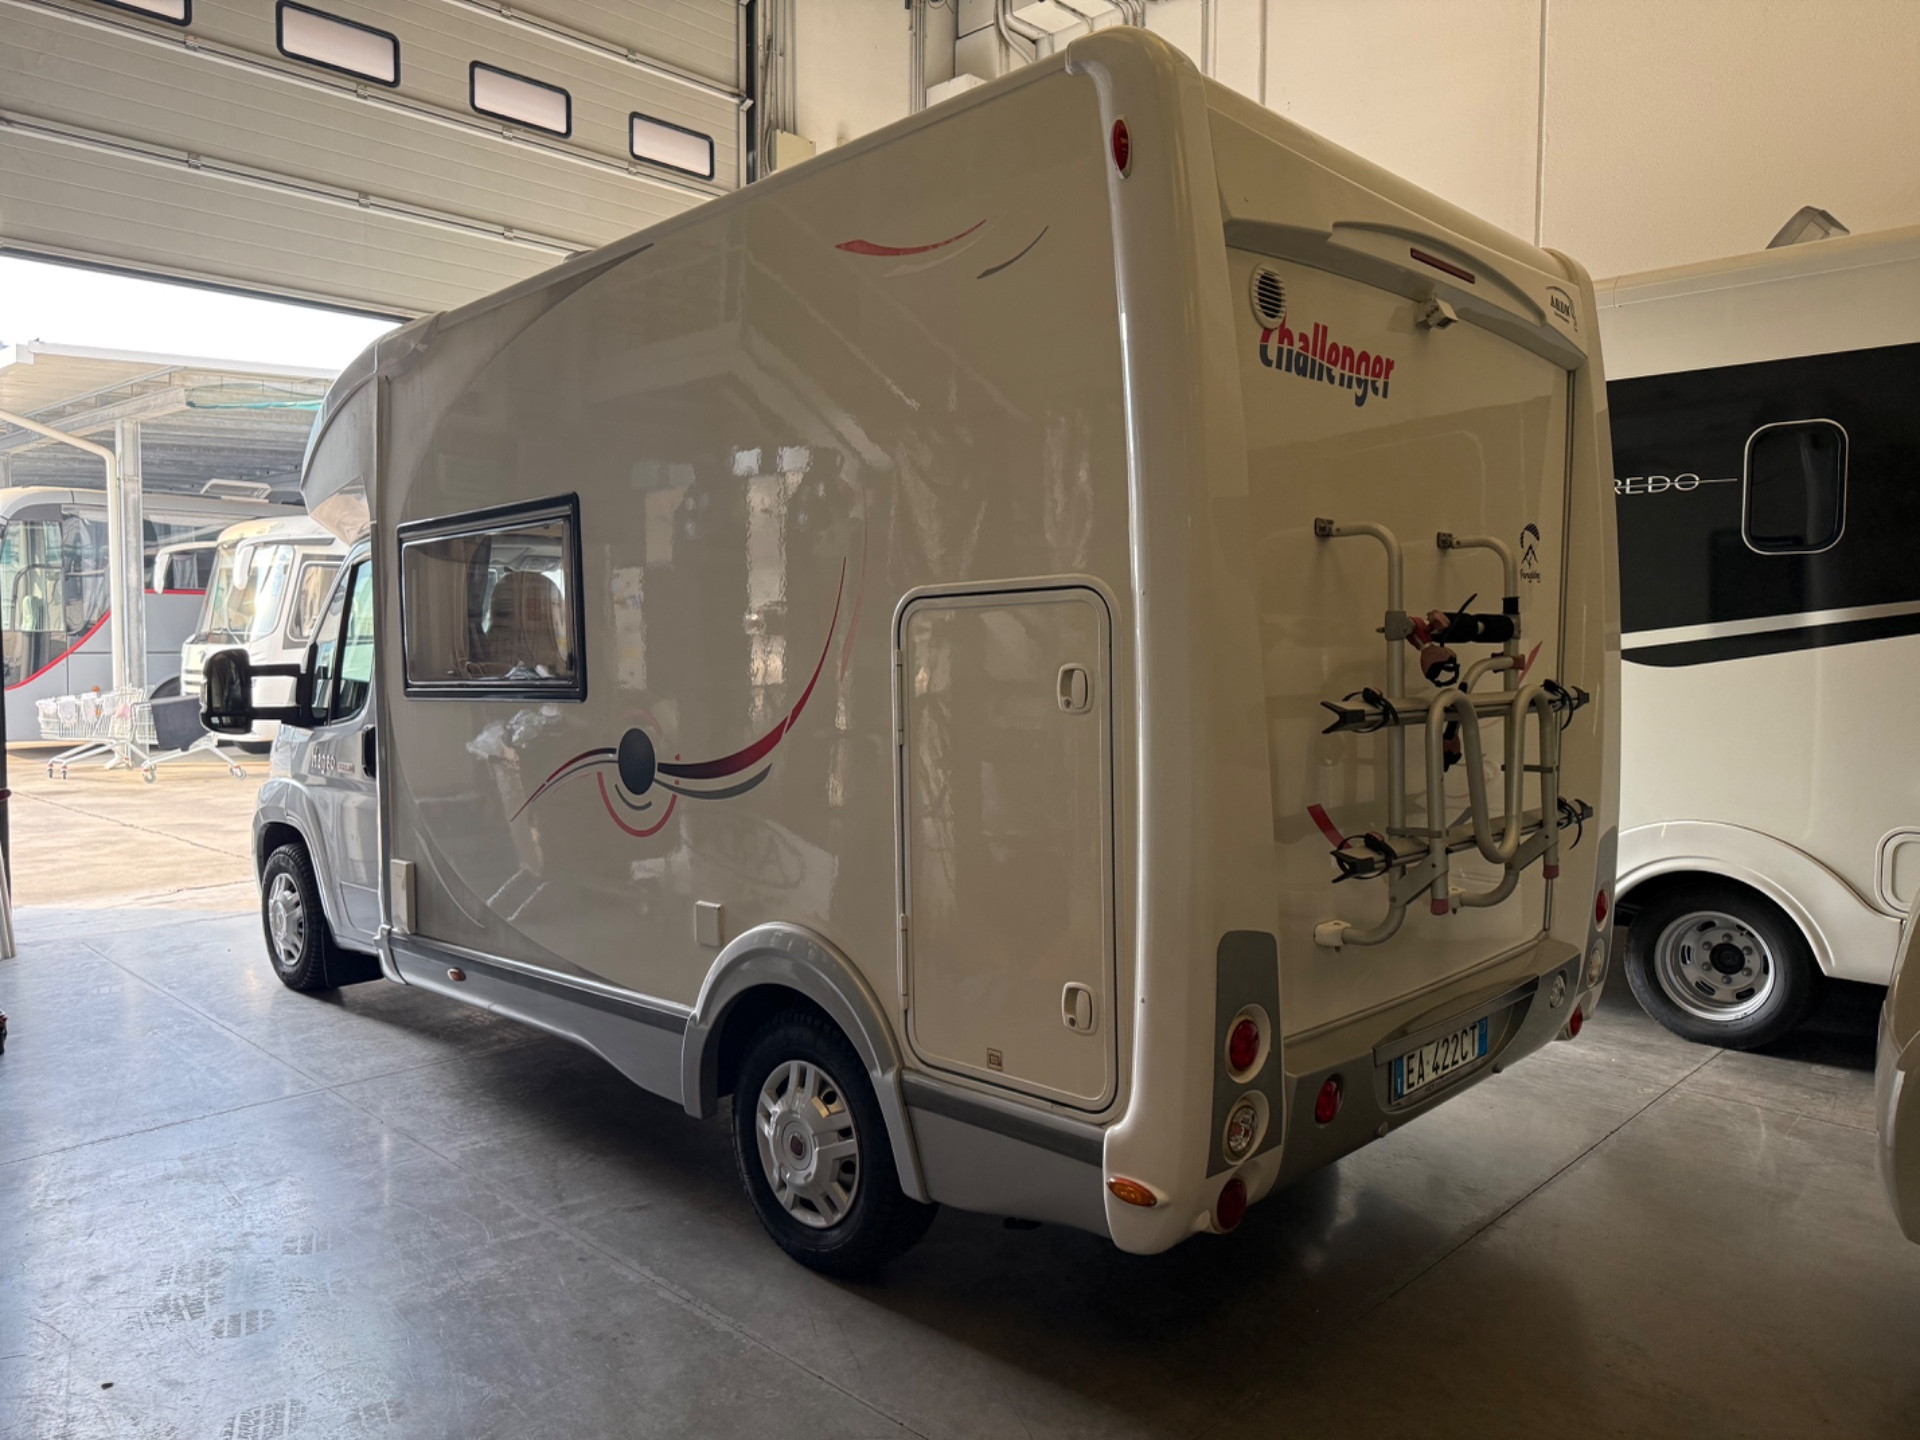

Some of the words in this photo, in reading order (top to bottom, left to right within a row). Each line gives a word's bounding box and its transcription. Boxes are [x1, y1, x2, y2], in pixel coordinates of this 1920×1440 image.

[1259, 314, 1395, 408] Challenger
[1406, 1050, 1425, 1089] EA
[1431, 1023, 1478, 1075] 422CT
